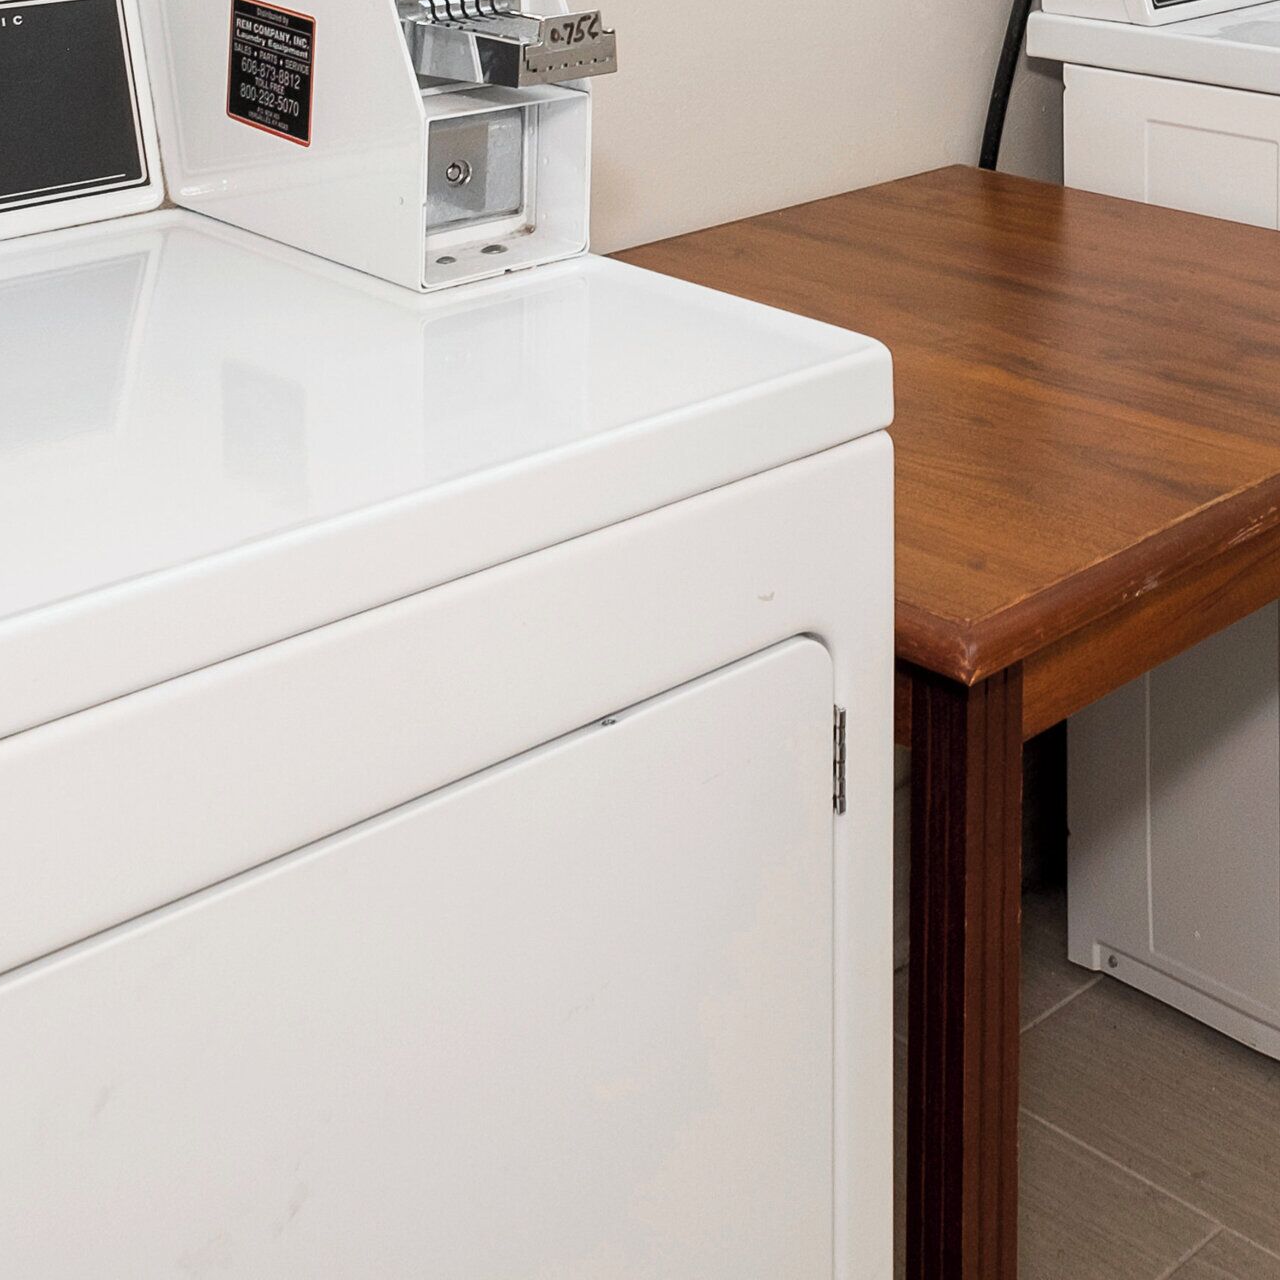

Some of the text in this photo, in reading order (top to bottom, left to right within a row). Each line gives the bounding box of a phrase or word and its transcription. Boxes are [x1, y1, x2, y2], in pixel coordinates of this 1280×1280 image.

[236, 17, 253, 30] REM
[293, 35, 310, 49] INC.
[236, 29, 309, 59] Laundry Equipment
[234, 42, 310, 75] SALES PARTS SERVICE
[240, 83, 300, 117] 800-292-5070
[255, 76, 285, 96] TOLL FREE
